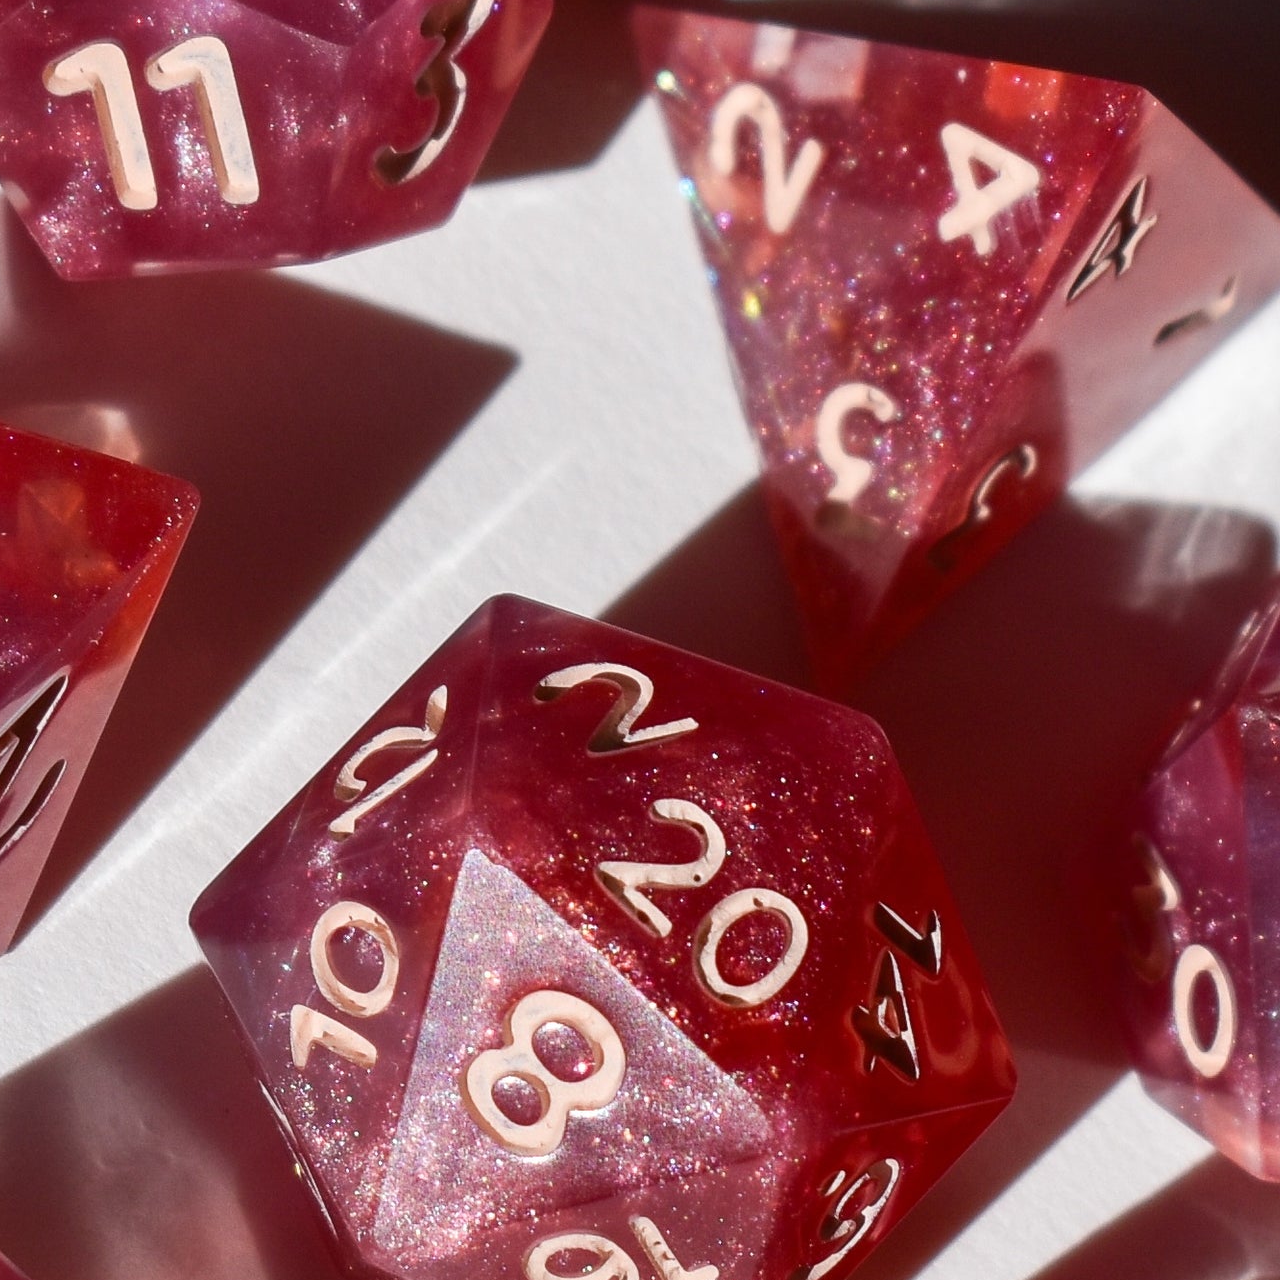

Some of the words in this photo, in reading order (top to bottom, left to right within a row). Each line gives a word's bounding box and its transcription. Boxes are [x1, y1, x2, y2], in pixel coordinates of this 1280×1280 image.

[41, 35, 260, 211] 11
[710, 82, 824, 234] 2
[938, 121, 1042, 256] 4
[531, 661, 701, 756] 2
[288, 900, 402, 1070] 10
[594, 798, 811, 1009] 20
[460, 989, 628, 1159] 8
